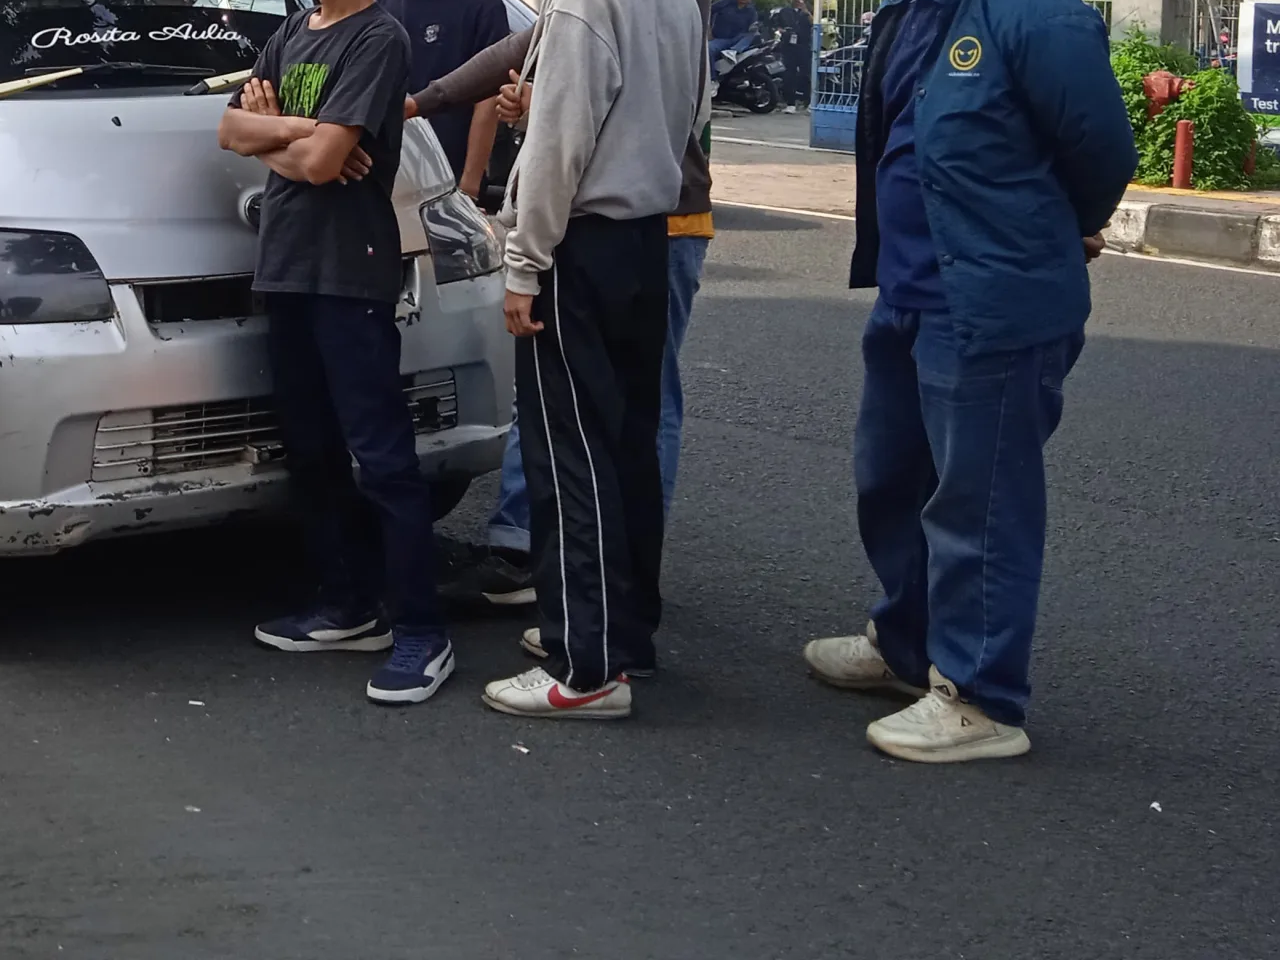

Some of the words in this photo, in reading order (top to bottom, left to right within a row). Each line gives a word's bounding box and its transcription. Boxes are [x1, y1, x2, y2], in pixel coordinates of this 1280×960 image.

[31, 26, 141, 49] Rosita
[148, 22, 242, 41] Aulia
[1250, 97, 1280, 111] Test
